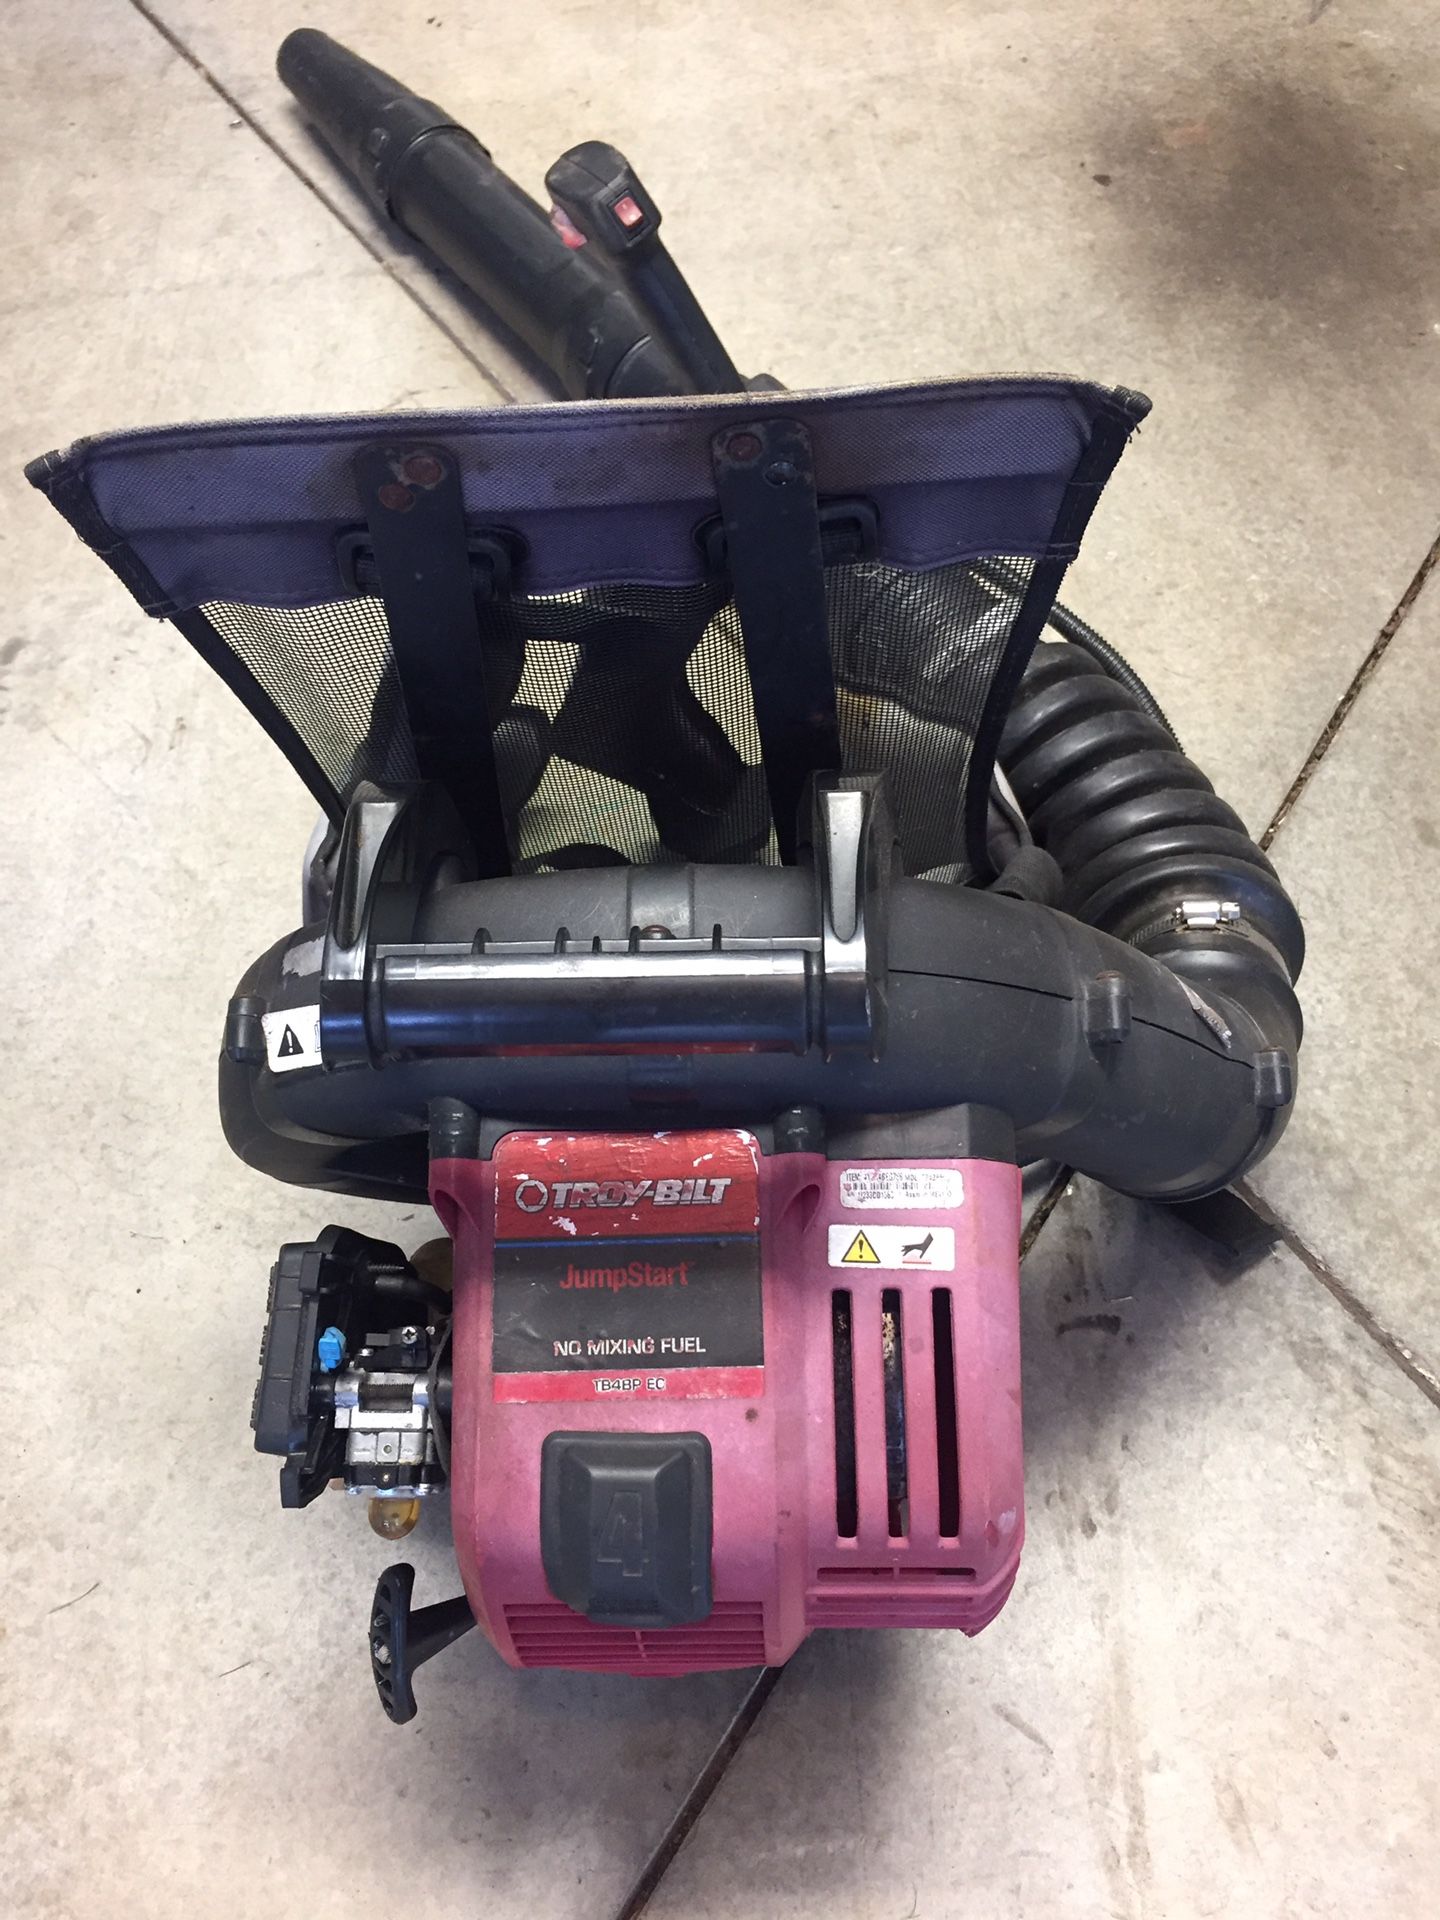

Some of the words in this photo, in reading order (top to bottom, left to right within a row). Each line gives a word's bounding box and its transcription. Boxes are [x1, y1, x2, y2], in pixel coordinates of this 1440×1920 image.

[551, 1178, 731, 1208] TROY-BILT
[559, 1261, 689, 1293] JumpStart
[553, 1340, 581, 1356] NO
[587, 1337, 655, 1355] MIXING
[660, 1336, 706, 1354] FUEL
[646, 1376, 667, 1392] EC
